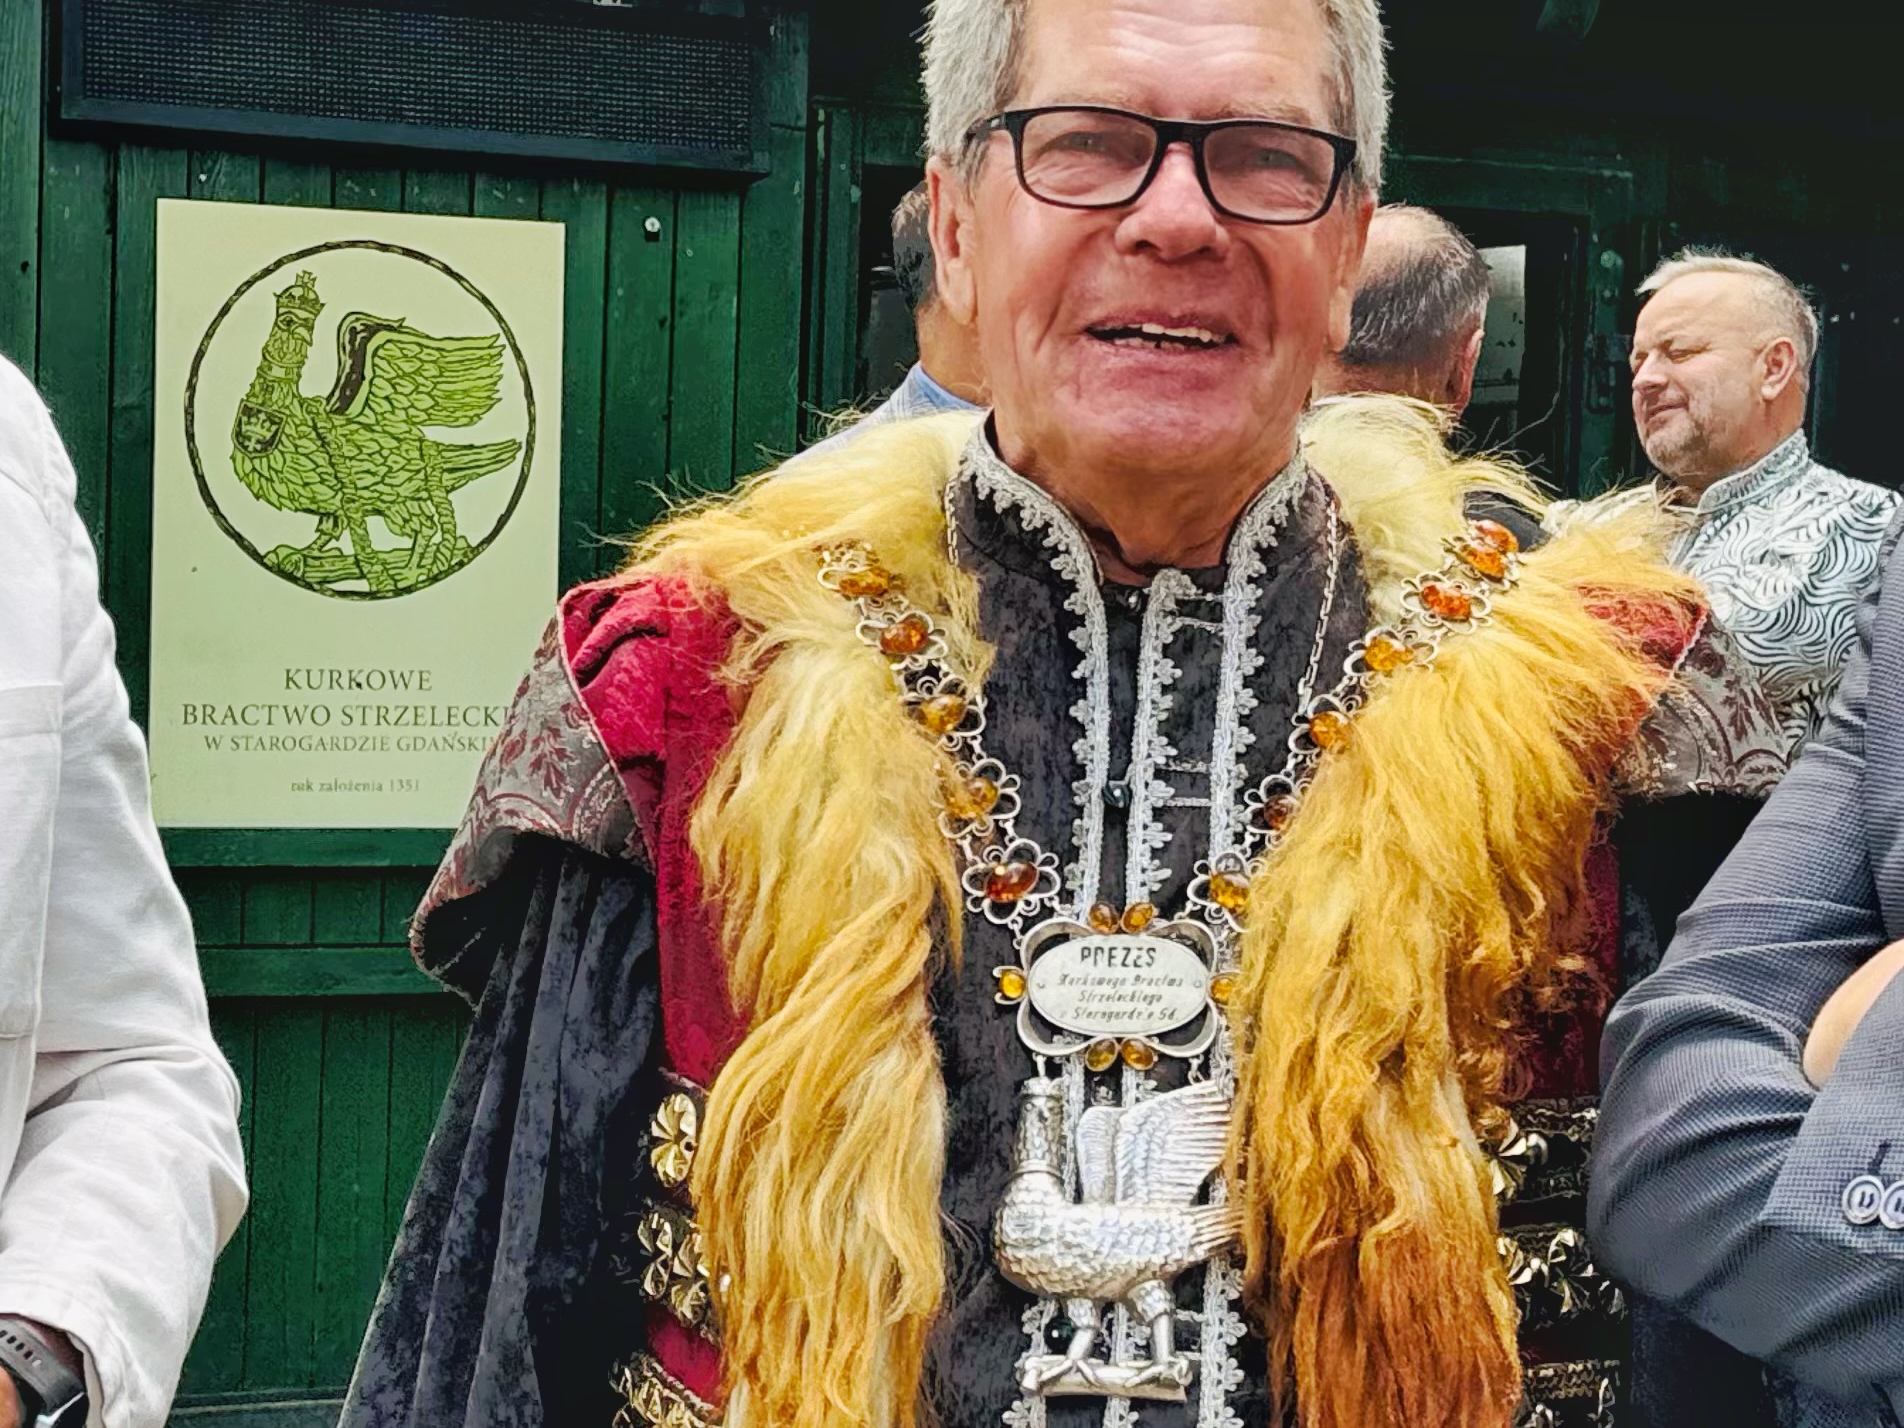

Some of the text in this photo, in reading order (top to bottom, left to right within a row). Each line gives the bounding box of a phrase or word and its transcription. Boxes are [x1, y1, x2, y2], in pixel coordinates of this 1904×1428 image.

[284, 669, 433, 692] KURKOWE
[182, 703, 509, 728] BRACTWO STRZELECKI
[204, 731, 495, 753] W STAROGARDZIE GDAŃSKI
[1080, 946, 1157, 968] PREZES
